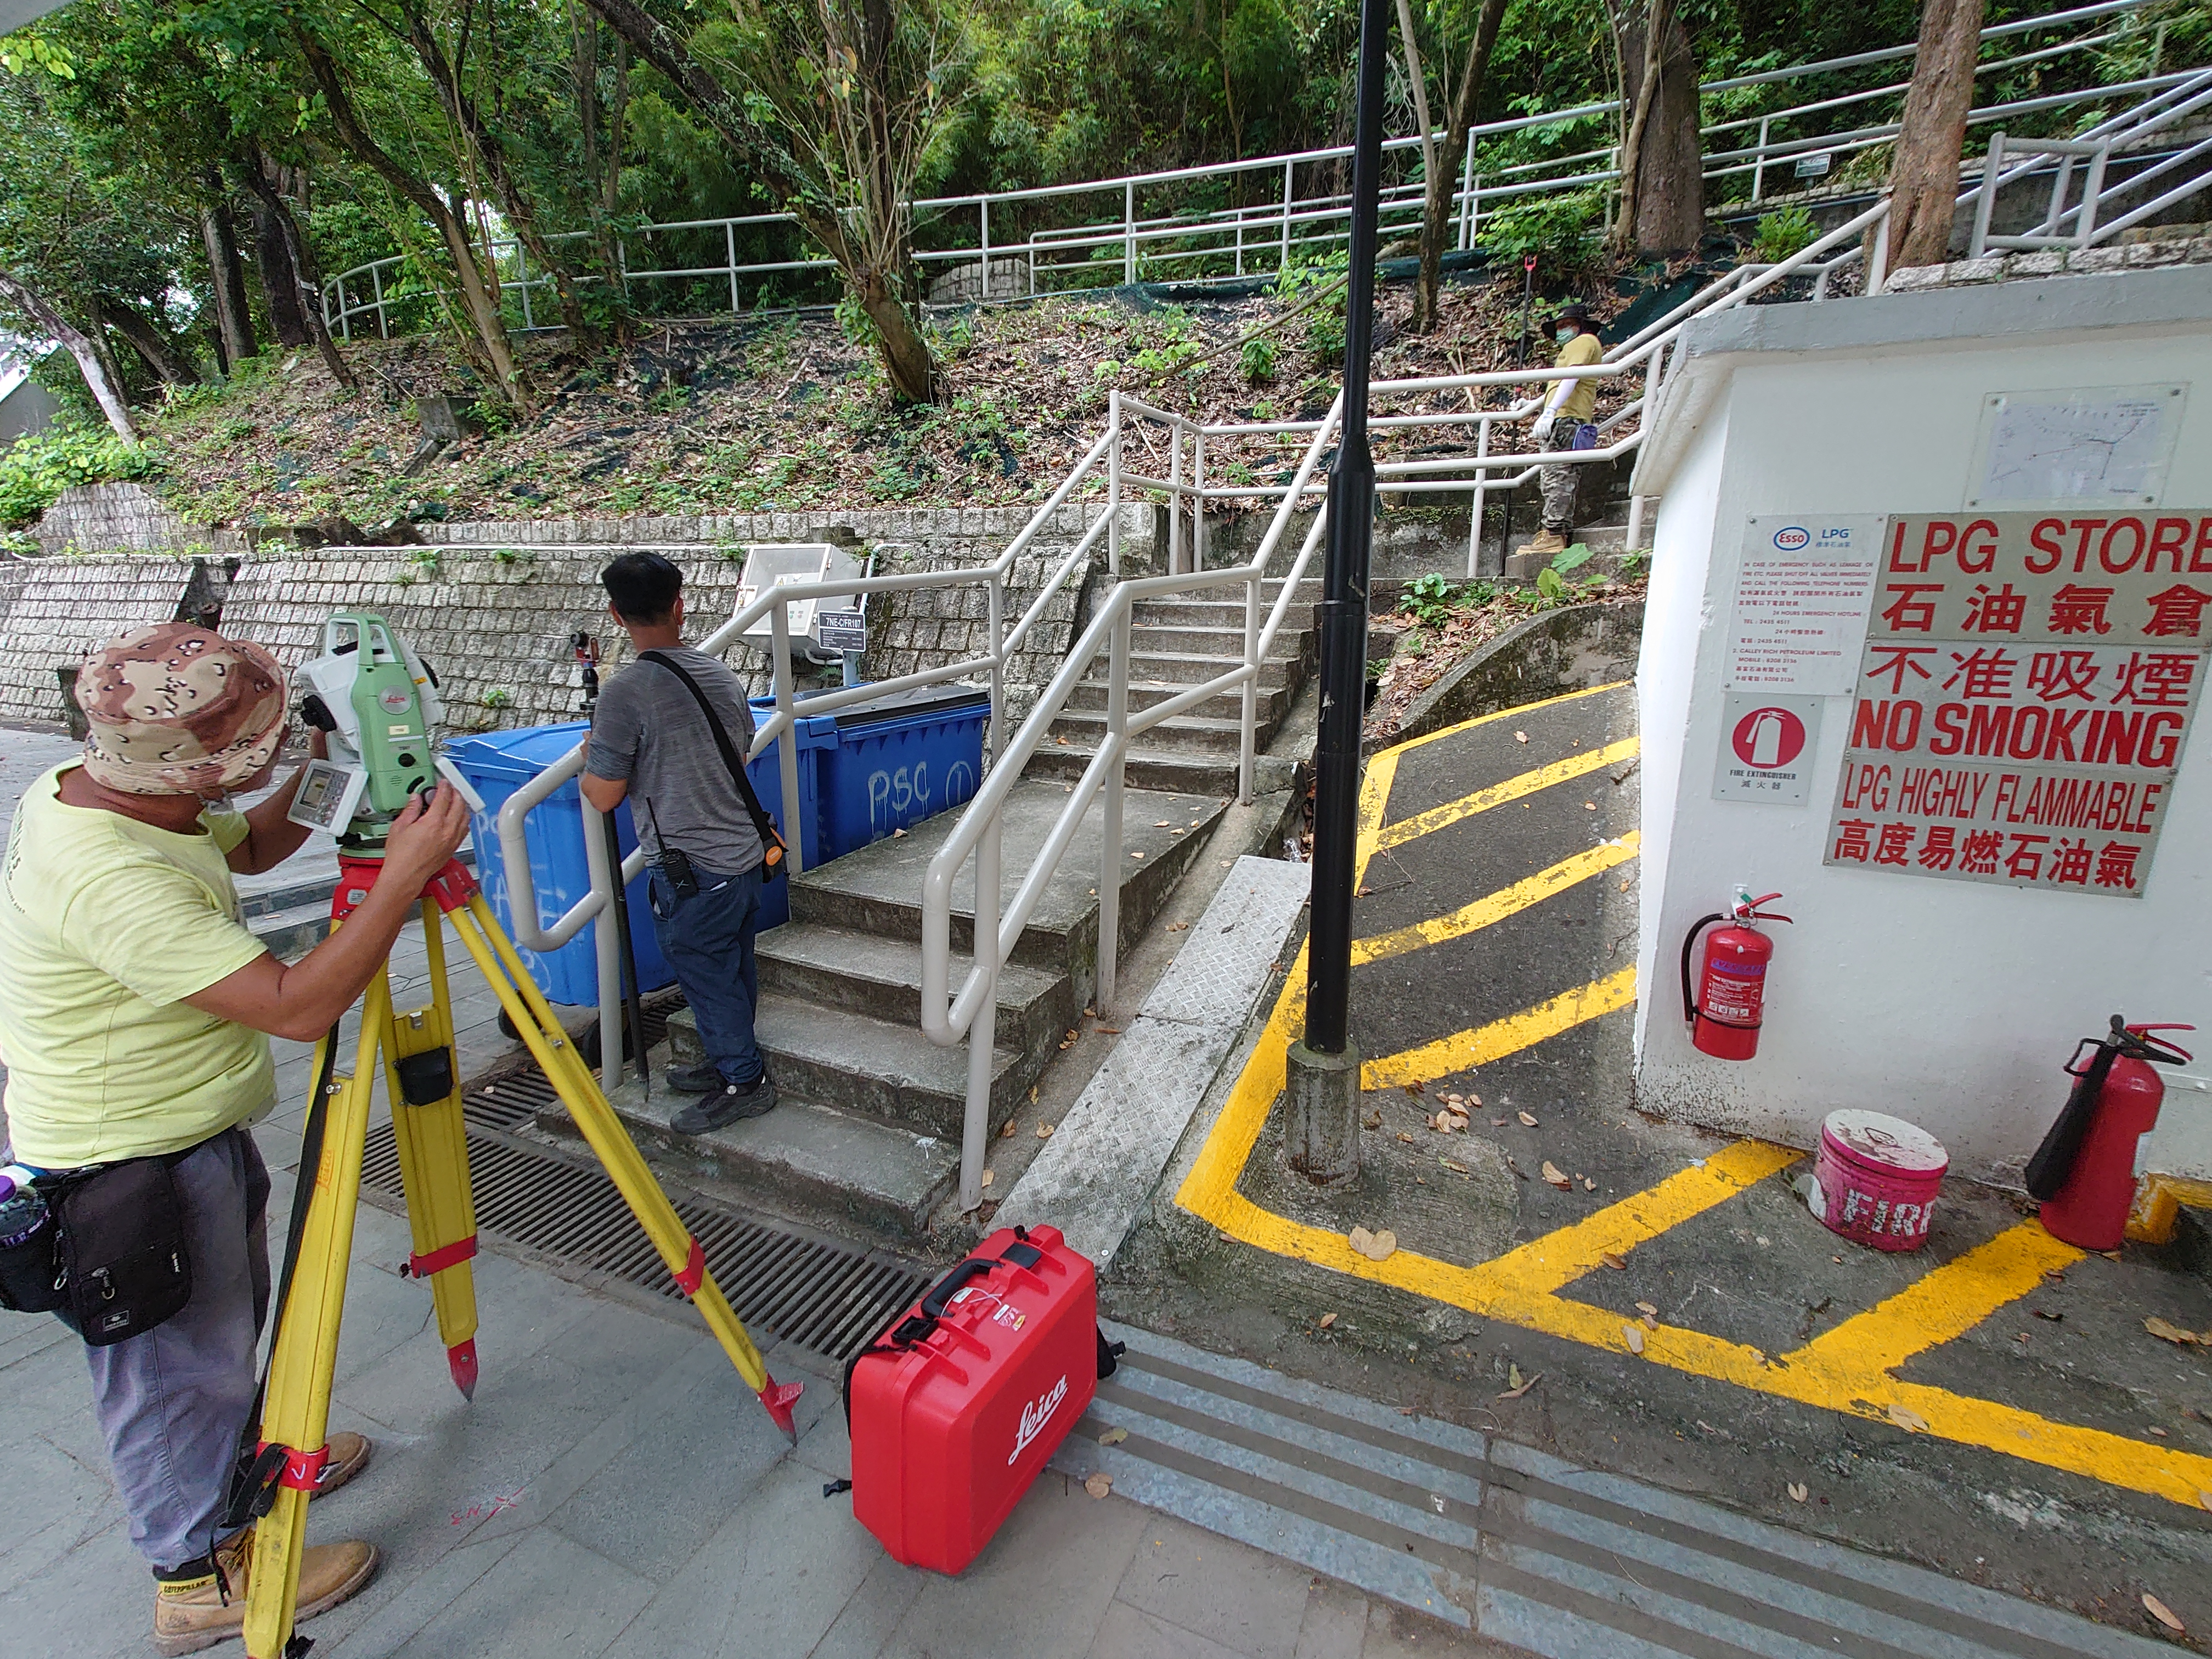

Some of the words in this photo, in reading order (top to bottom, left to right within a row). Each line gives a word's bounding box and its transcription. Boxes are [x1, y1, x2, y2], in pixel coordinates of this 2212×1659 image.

[1779, 533, 1805, 544] Esso
[1822, 529, 1849, 538] LPG
[1889, 519, 1999, 574] LPG
[826, 617, 861, 628] 7NE-C/FR107
[1882, 584, 2212, 637] 石油氣倉
[1866, 646, 2199, 707] 不准吸煙
[1850, 699, 1922, 752] NO
[1929, 702, 2185, 768] SMOKING
[868, 761, 931, 834] PSC
[1741, 780, 1781, 791] 滅火器
[1747, 770, 1797, 780] EXTINGUISHER
[1842, 763, 1892, 812] LPG
[1897, 767, 1991, 819] HIGHLY
[1991, 774, 2162, 834] FLAMMABLE
[1834, 817, 2142, 889] 高度易燃石油氣
[1008, 1374, 1068, 1466] Leica
